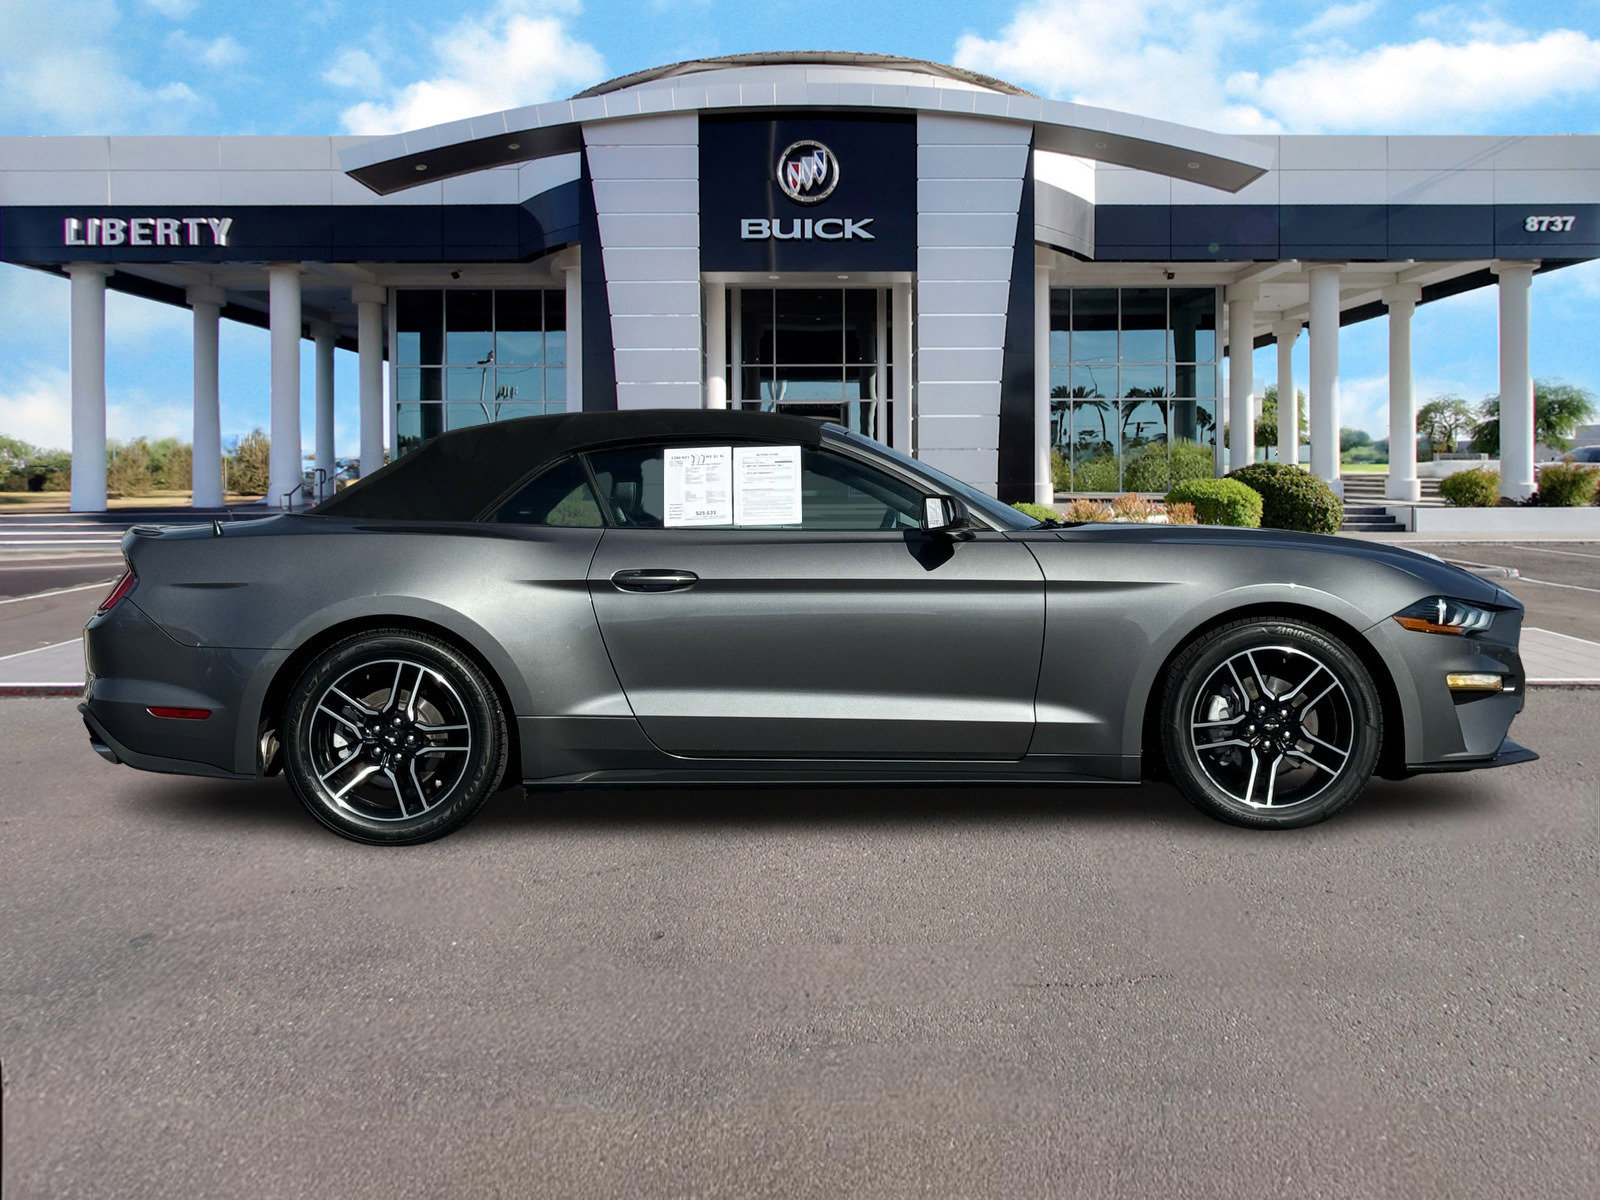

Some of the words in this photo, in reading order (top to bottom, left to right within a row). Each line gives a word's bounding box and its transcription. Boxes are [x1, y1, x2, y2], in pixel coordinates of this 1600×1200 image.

[64, 217, 233, 247] LIBERTY
[740, 218, 876, 240] BUICK
[1525, 215, 1576, 232] 8737
[1277, 626, 1345, 660] BRIDGESTONE
